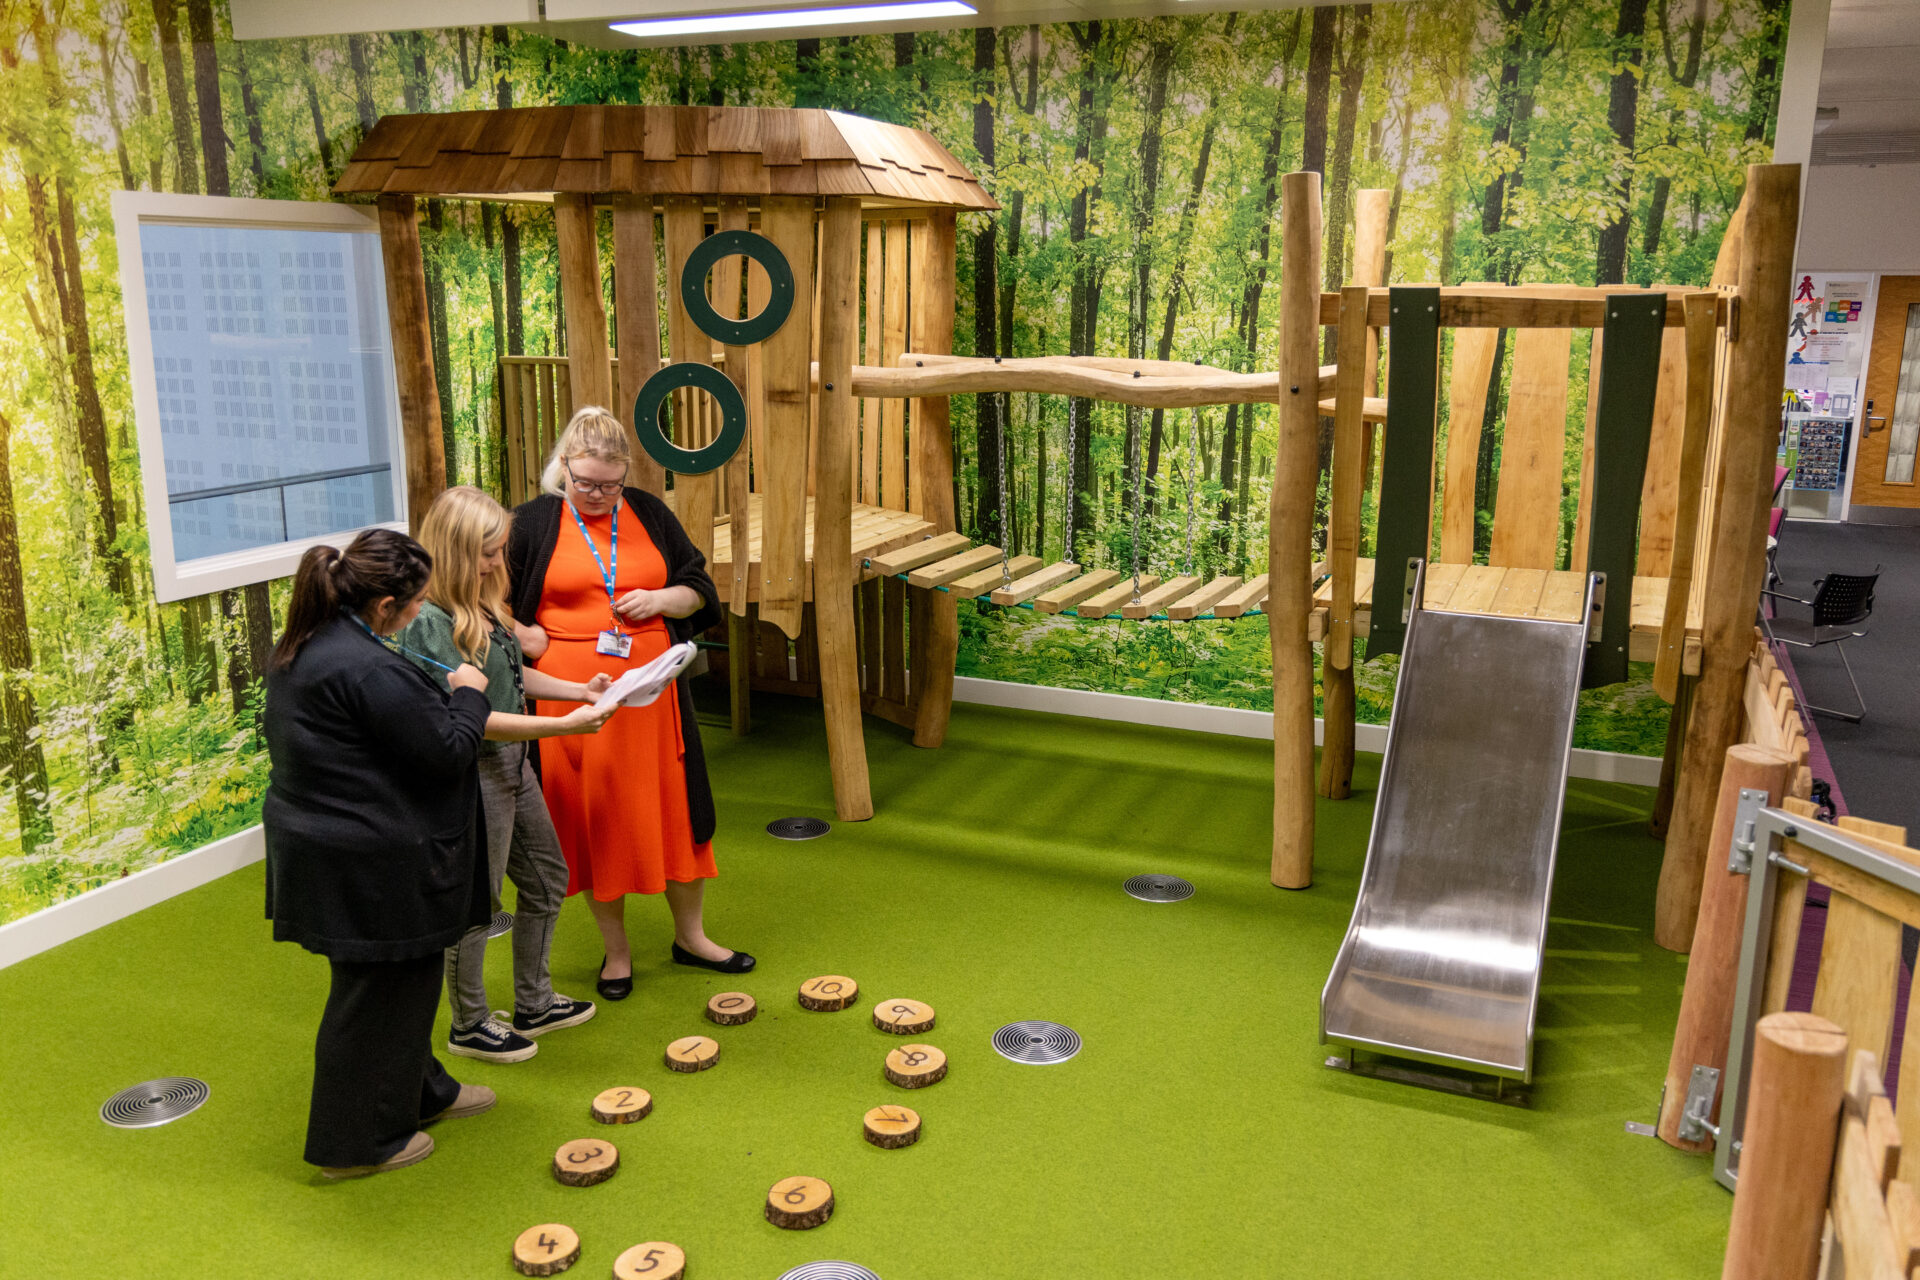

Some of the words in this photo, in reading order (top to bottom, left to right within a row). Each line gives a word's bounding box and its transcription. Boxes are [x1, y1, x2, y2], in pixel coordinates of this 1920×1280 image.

[811, 979, 842, 993] 10
[717, 997, 745, 1009] 0
[892, 1004, 917, 1016] 9
[681, 1042, 702, 1056] 1
[904, 1051, 929, 1067] 8
[615, 1090, 634, 1108] 2
[873, 1113, 909, 1124] 7
[567, 1147, 603, 1164] 3
[783, 1185, 807, 1205] 6
[538, 1232, 559, 1254] 4
[634, 1249, 665, 1273] 5
